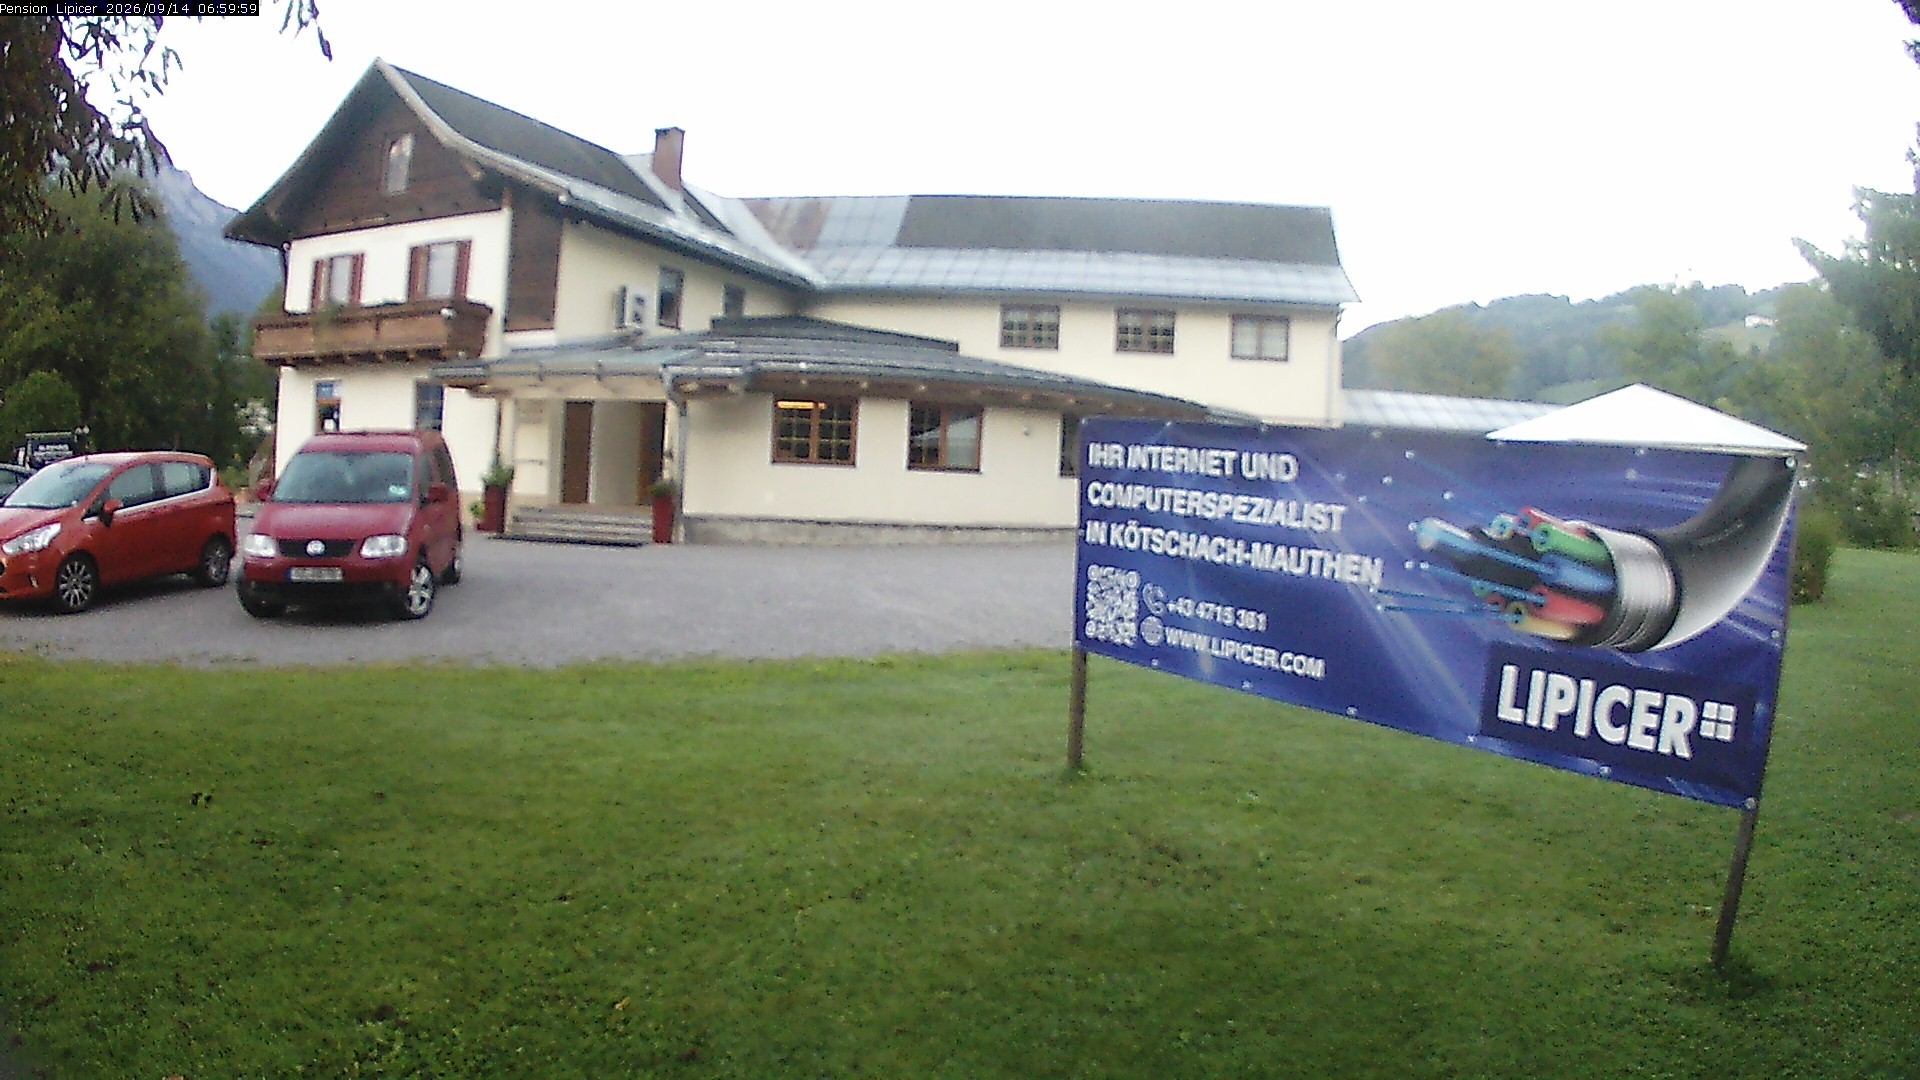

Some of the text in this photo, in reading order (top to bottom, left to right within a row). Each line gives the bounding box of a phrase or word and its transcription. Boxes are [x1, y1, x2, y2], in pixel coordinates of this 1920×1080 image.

[1088, 442, 1299, 482] IHR INTERNET UND
[1087, 481, 1348, 533] COMPUTERSPEZIALIST
[1085, 519, 1385, 585] IN KÖTSCHACH-MAUTHEN
[1166, 597, 1195, 618] +43
[1196, 601, 1235, 627] 4715
[1165, 626, 1326, 679] WWW.LIPICER.COM
[1497, 664, 1697, 760] LIPICER
